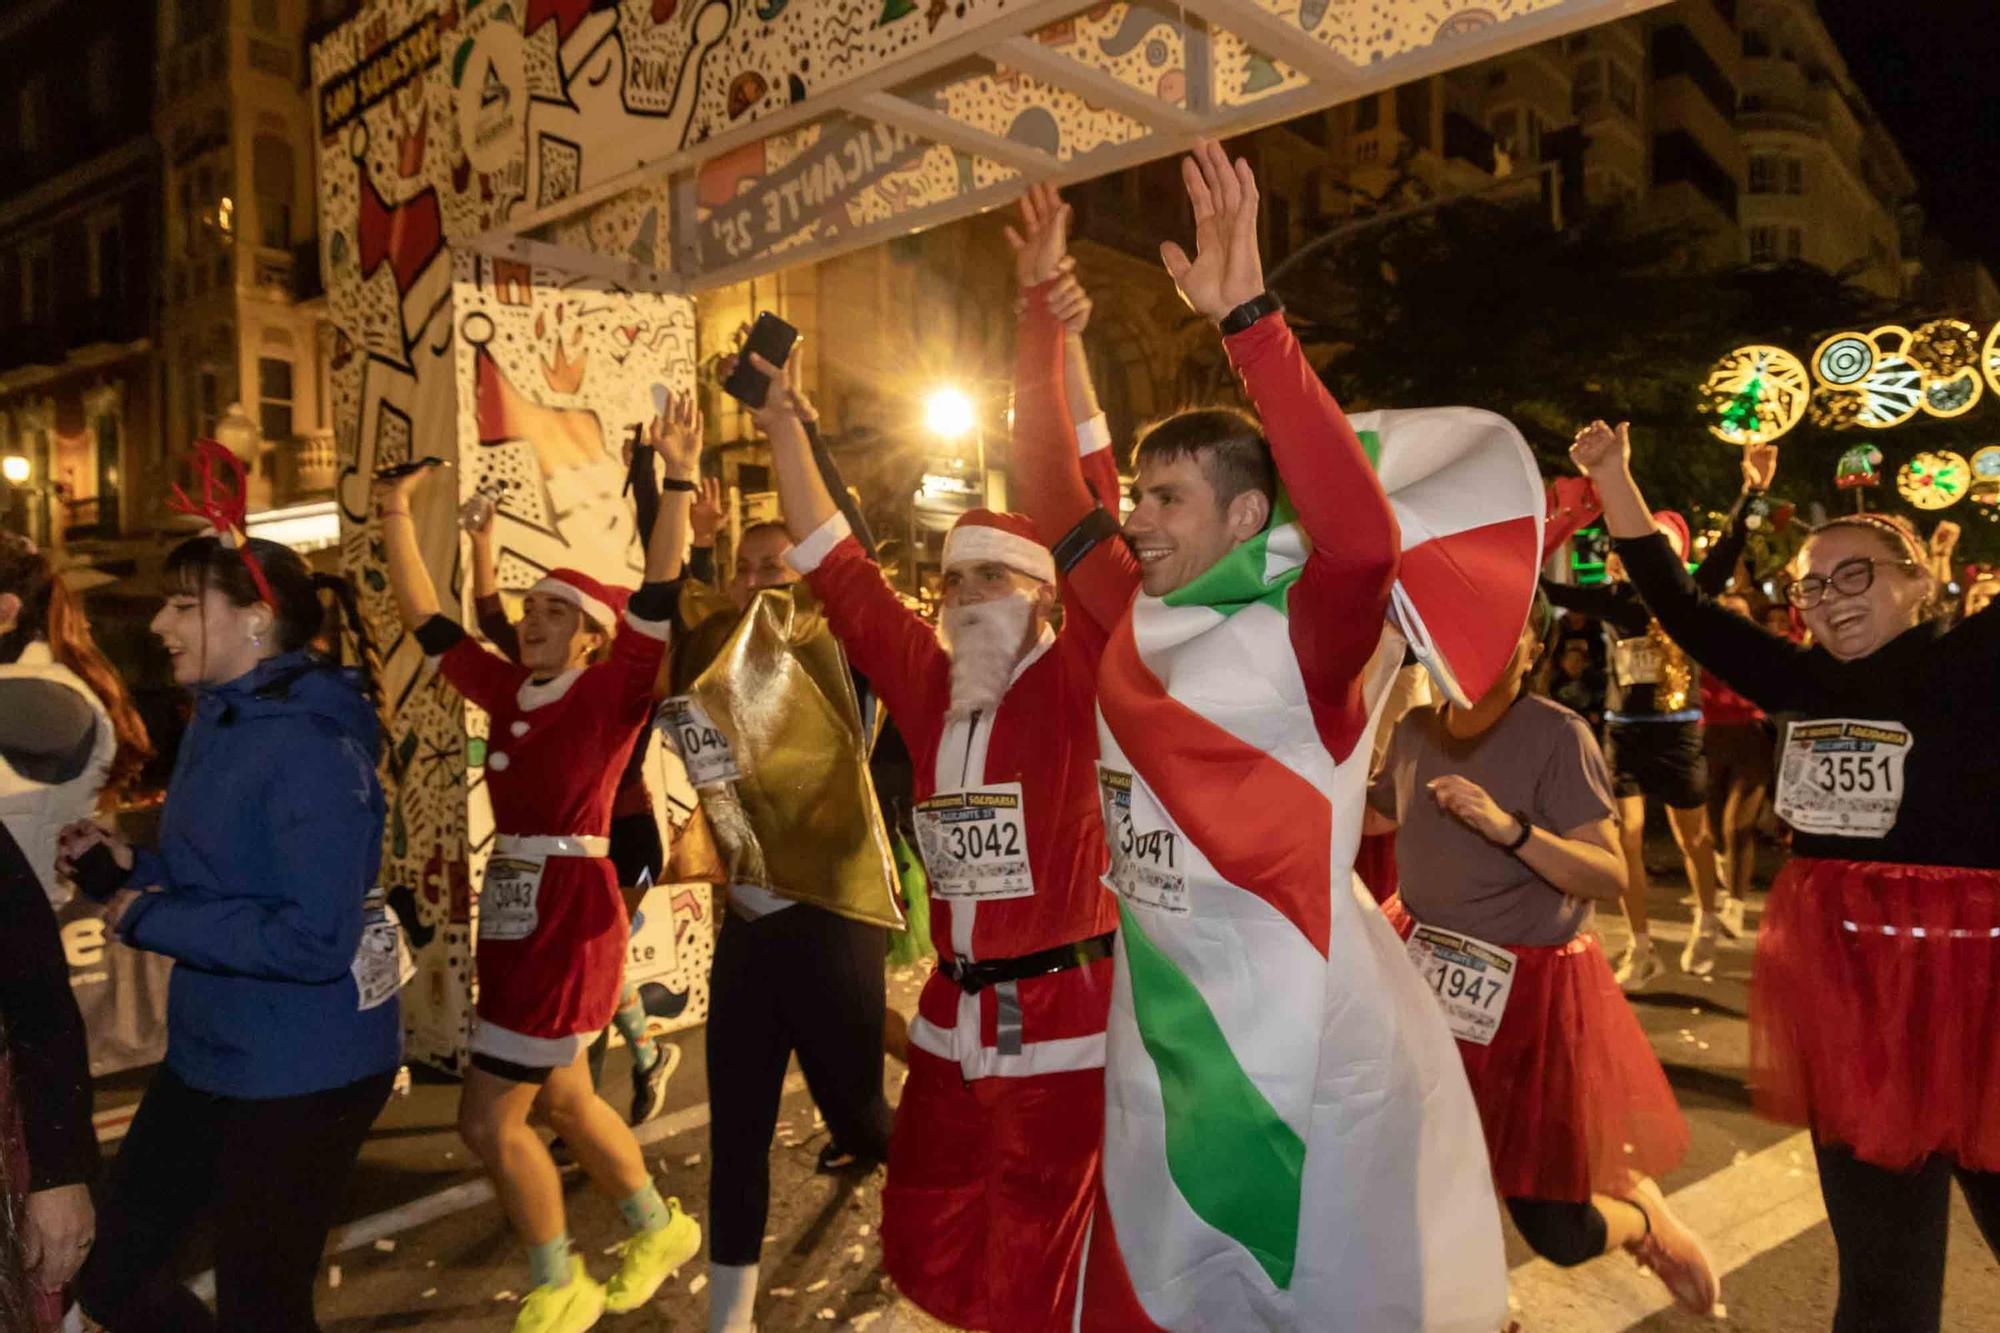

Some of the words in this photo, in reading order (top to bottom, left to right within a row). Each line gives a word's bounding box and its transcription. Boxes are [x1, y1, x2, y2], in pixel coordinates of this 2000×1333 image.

[631, 56, 669, 91] RUN
[1820, 756, 1892, 792] 3551
[951, 822, 1020, 860] 3042
[1437, 964, 1502, 1009] 1947
